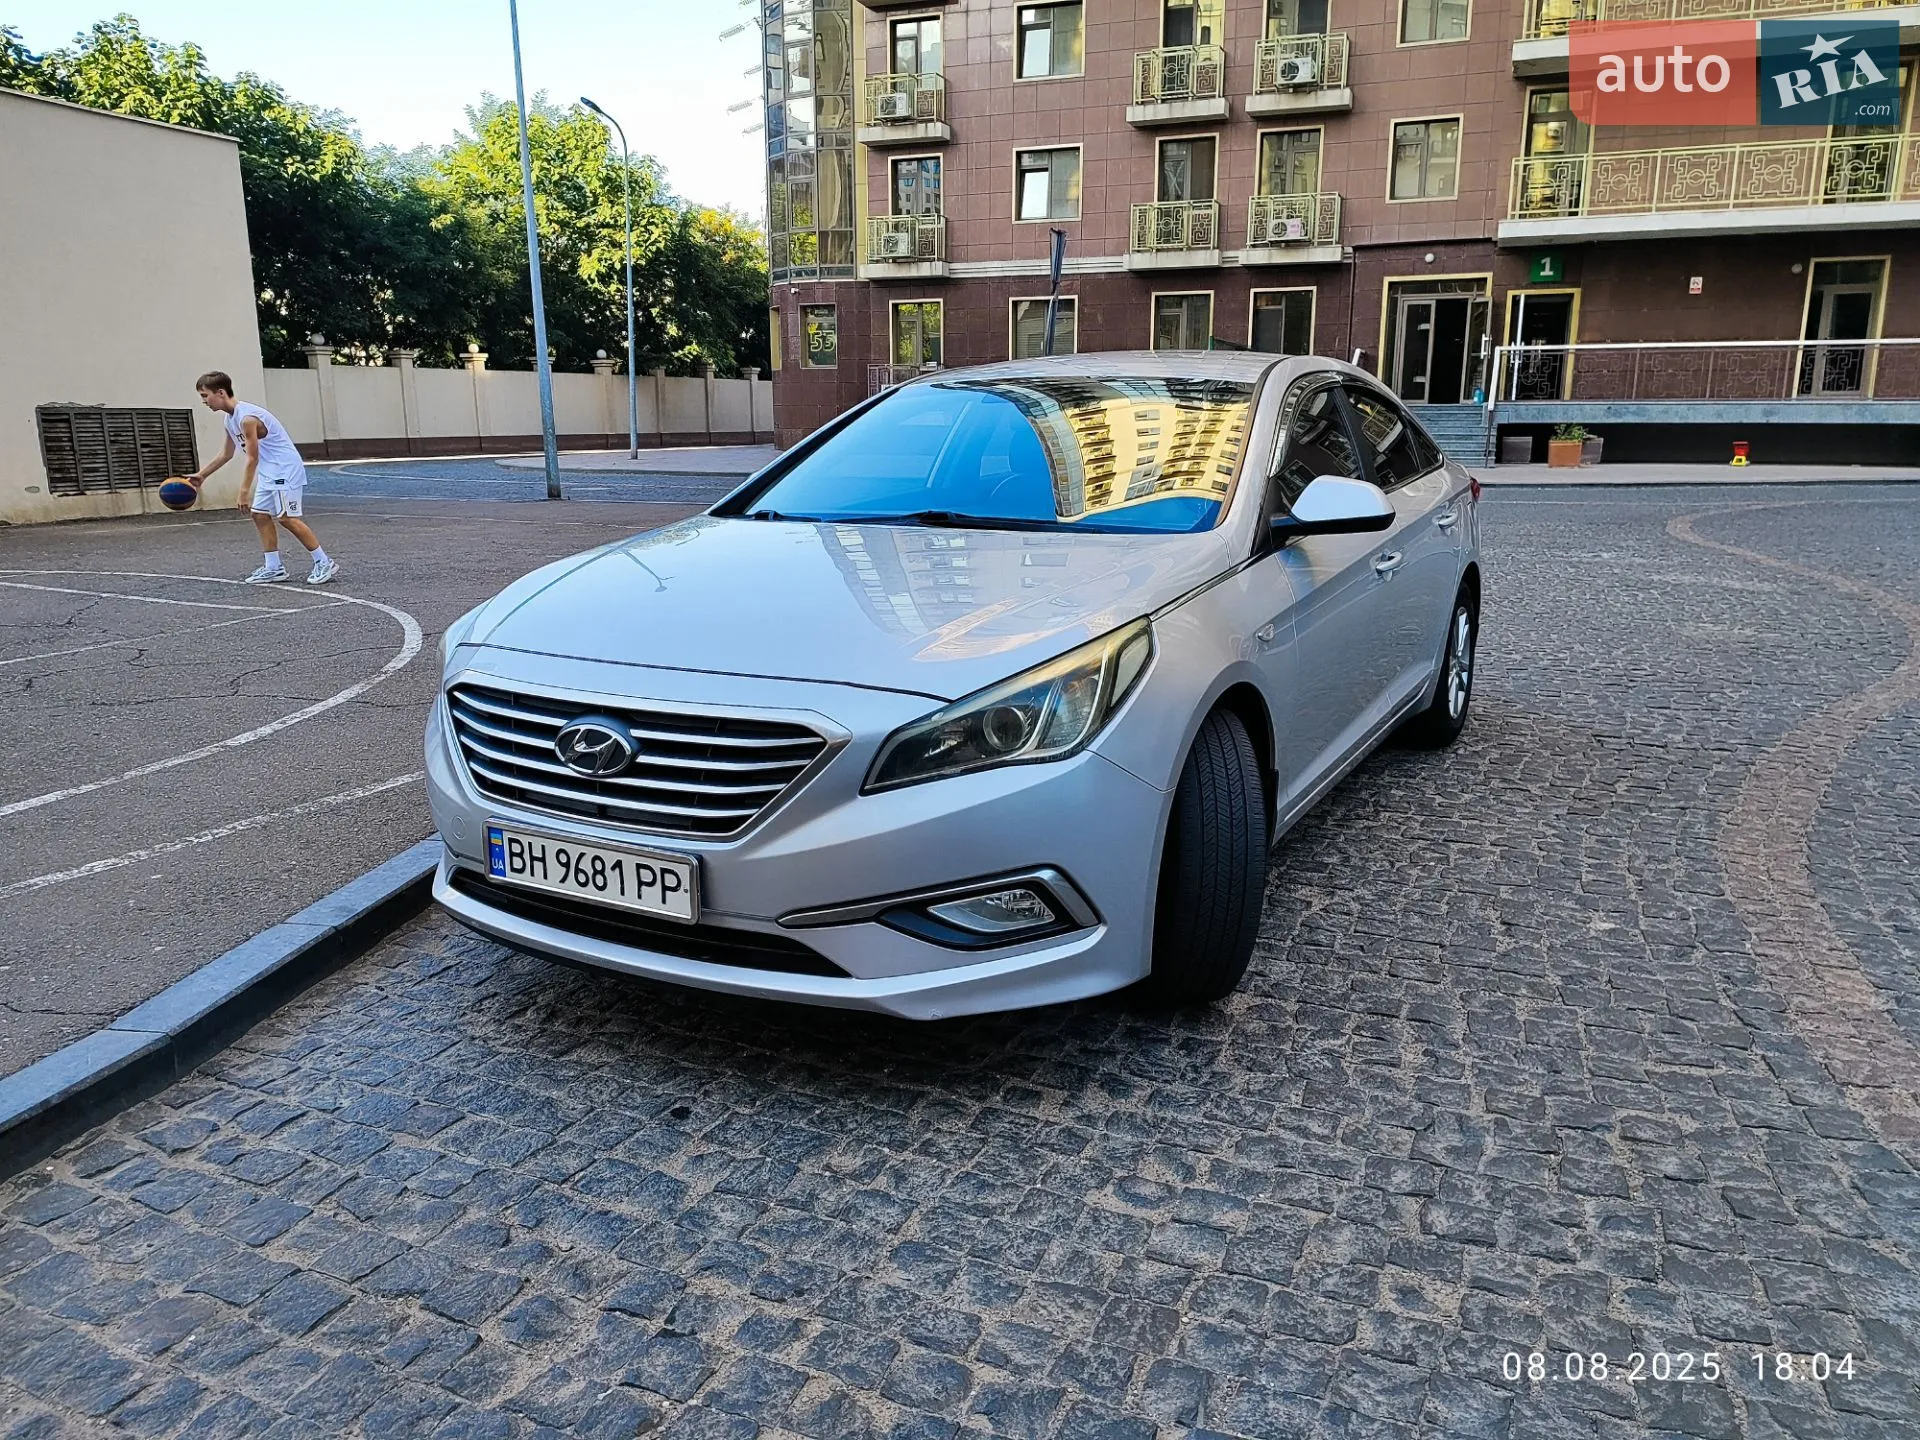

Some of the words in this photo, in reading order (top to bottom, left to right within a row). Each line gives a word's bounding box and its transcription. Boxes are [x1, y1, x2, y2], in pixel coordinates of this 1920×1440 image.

[1539, 256, 1554, 276] 1
[491, 857, 505, 871] UA
[507, 836, 548, 880] BH
[555, 847, 625, 897] 9681
[635, 861, 682, 905] PP
